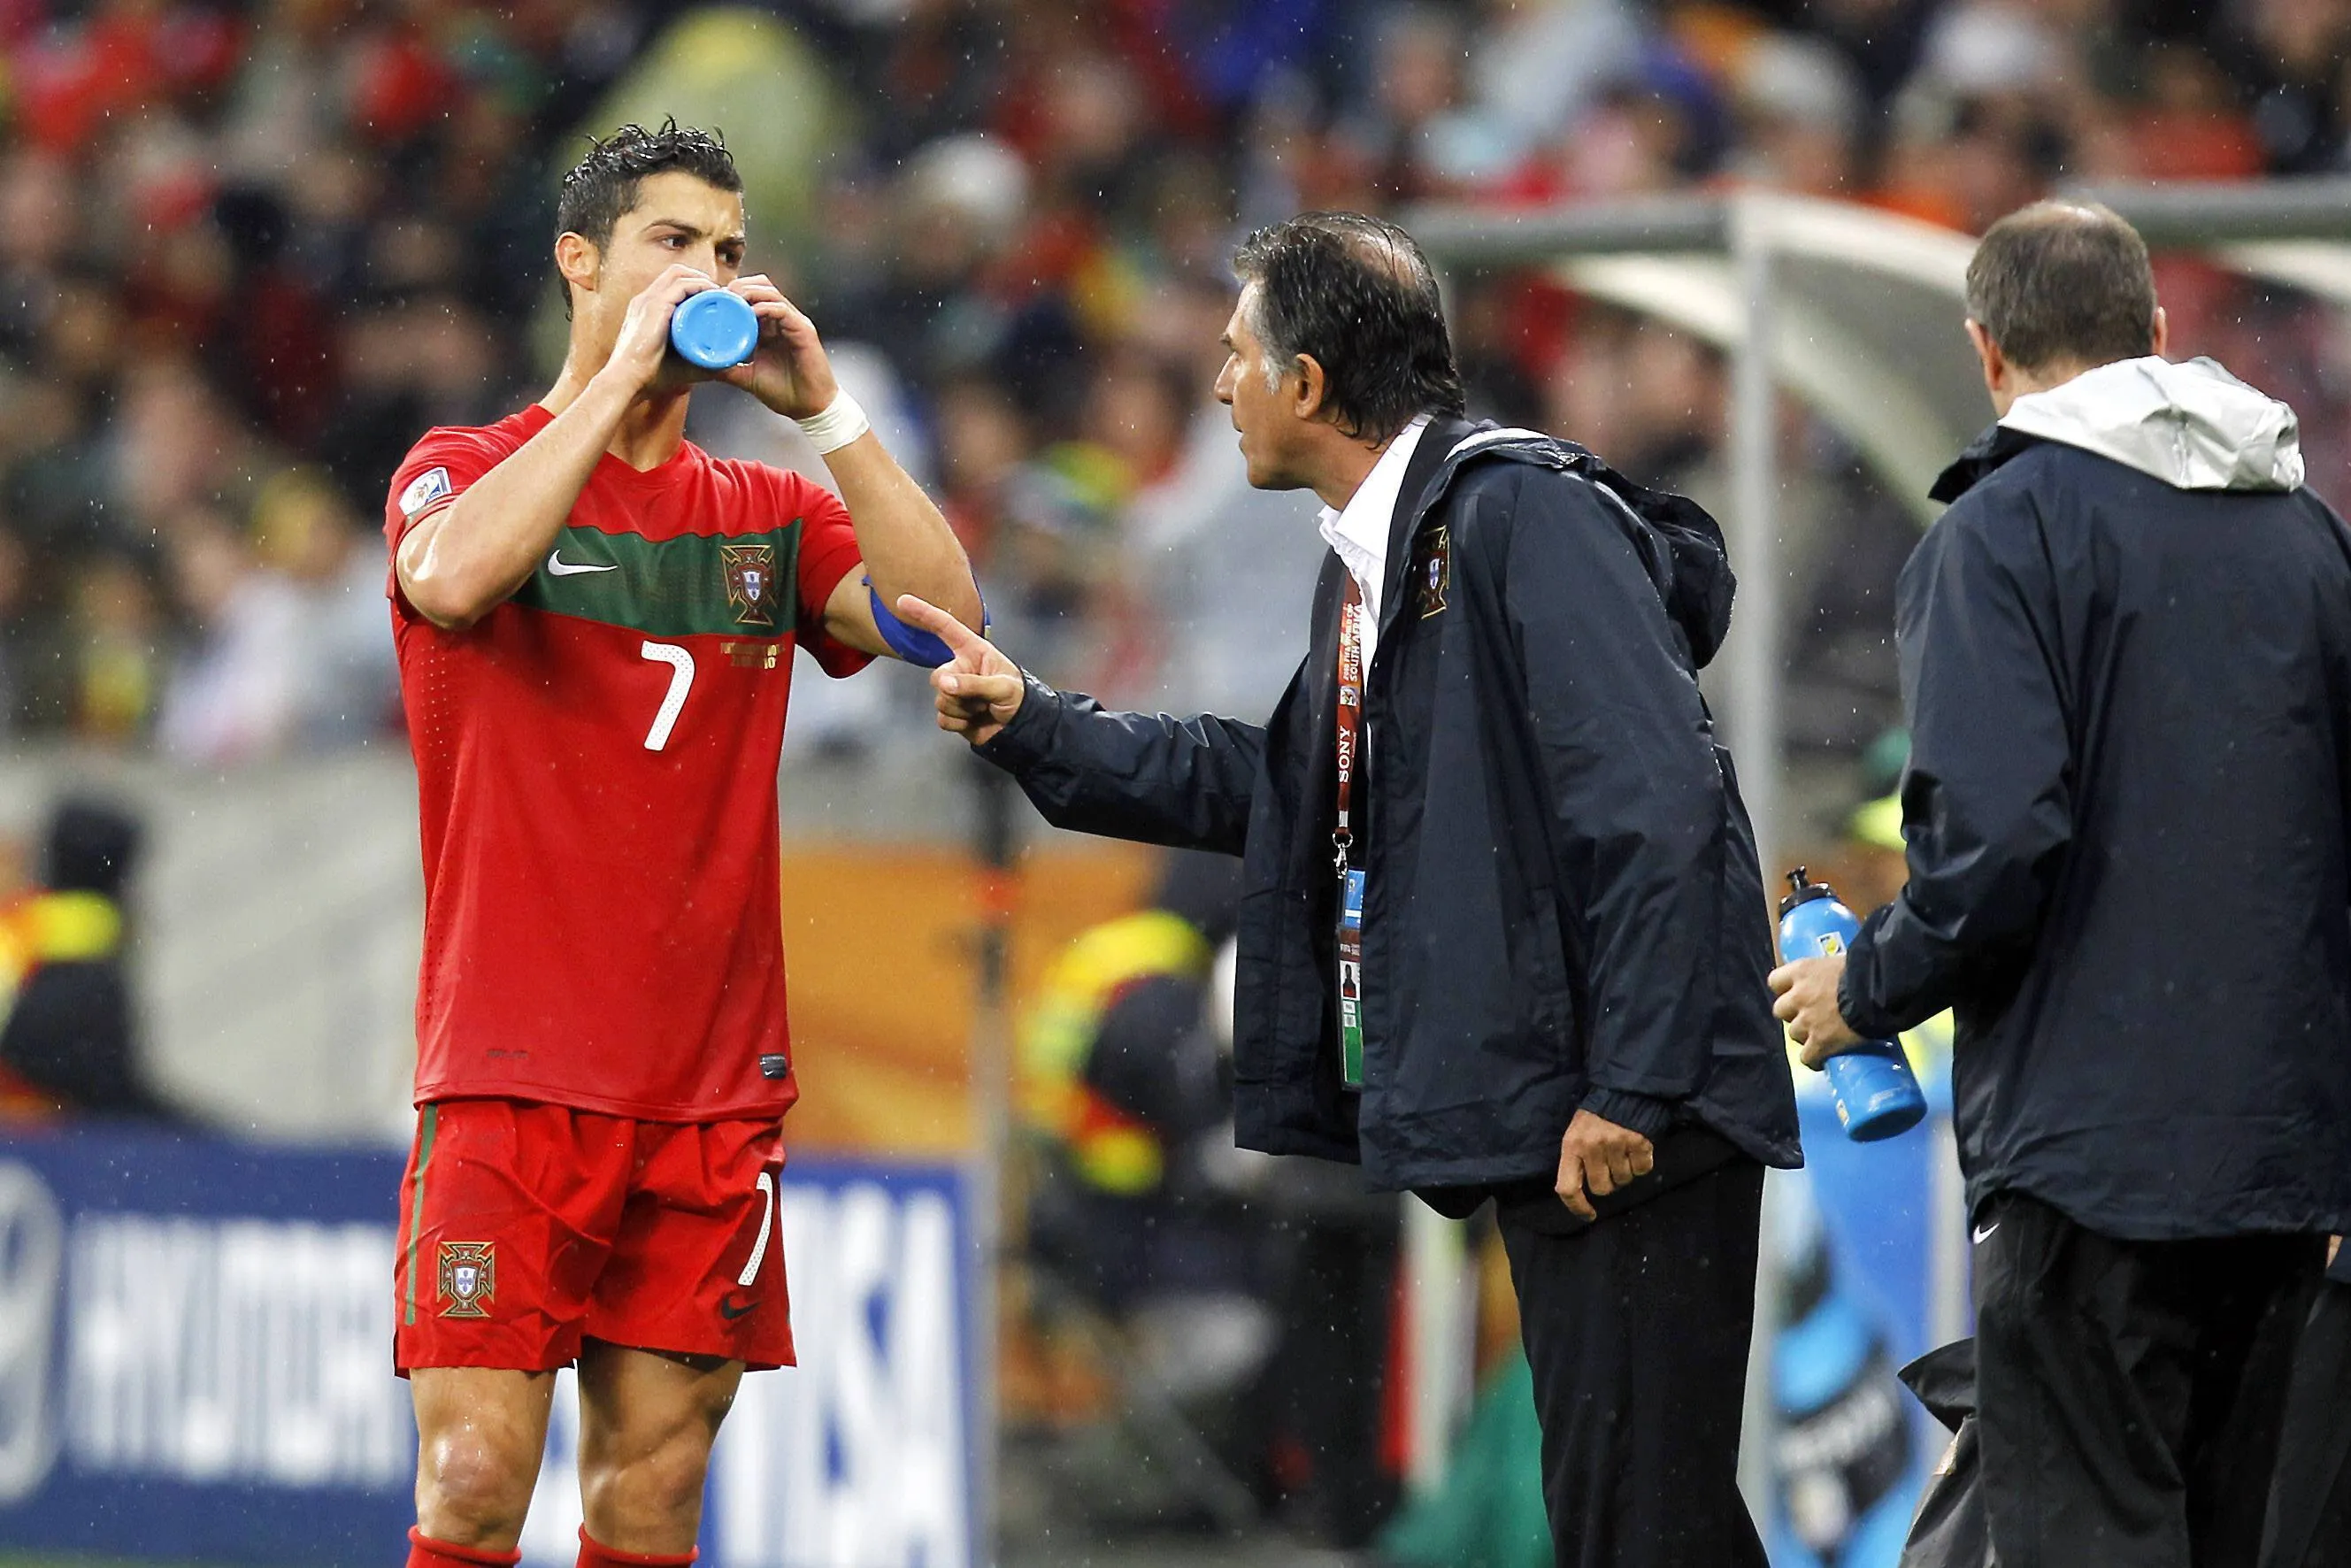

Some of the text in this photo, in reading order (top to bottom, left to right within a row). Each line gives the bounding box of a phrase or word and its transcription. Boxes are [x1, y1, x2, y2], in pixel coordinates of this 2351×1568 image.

[1344, 619, 1353, 646] WORLD
[1349, 604, 1362, 682] SOUTH AFRICA
[641, 640, 695, 751] 7
[1338, 726, 1350, 783] SONY
[738, 1172, 772, 1287] 7
